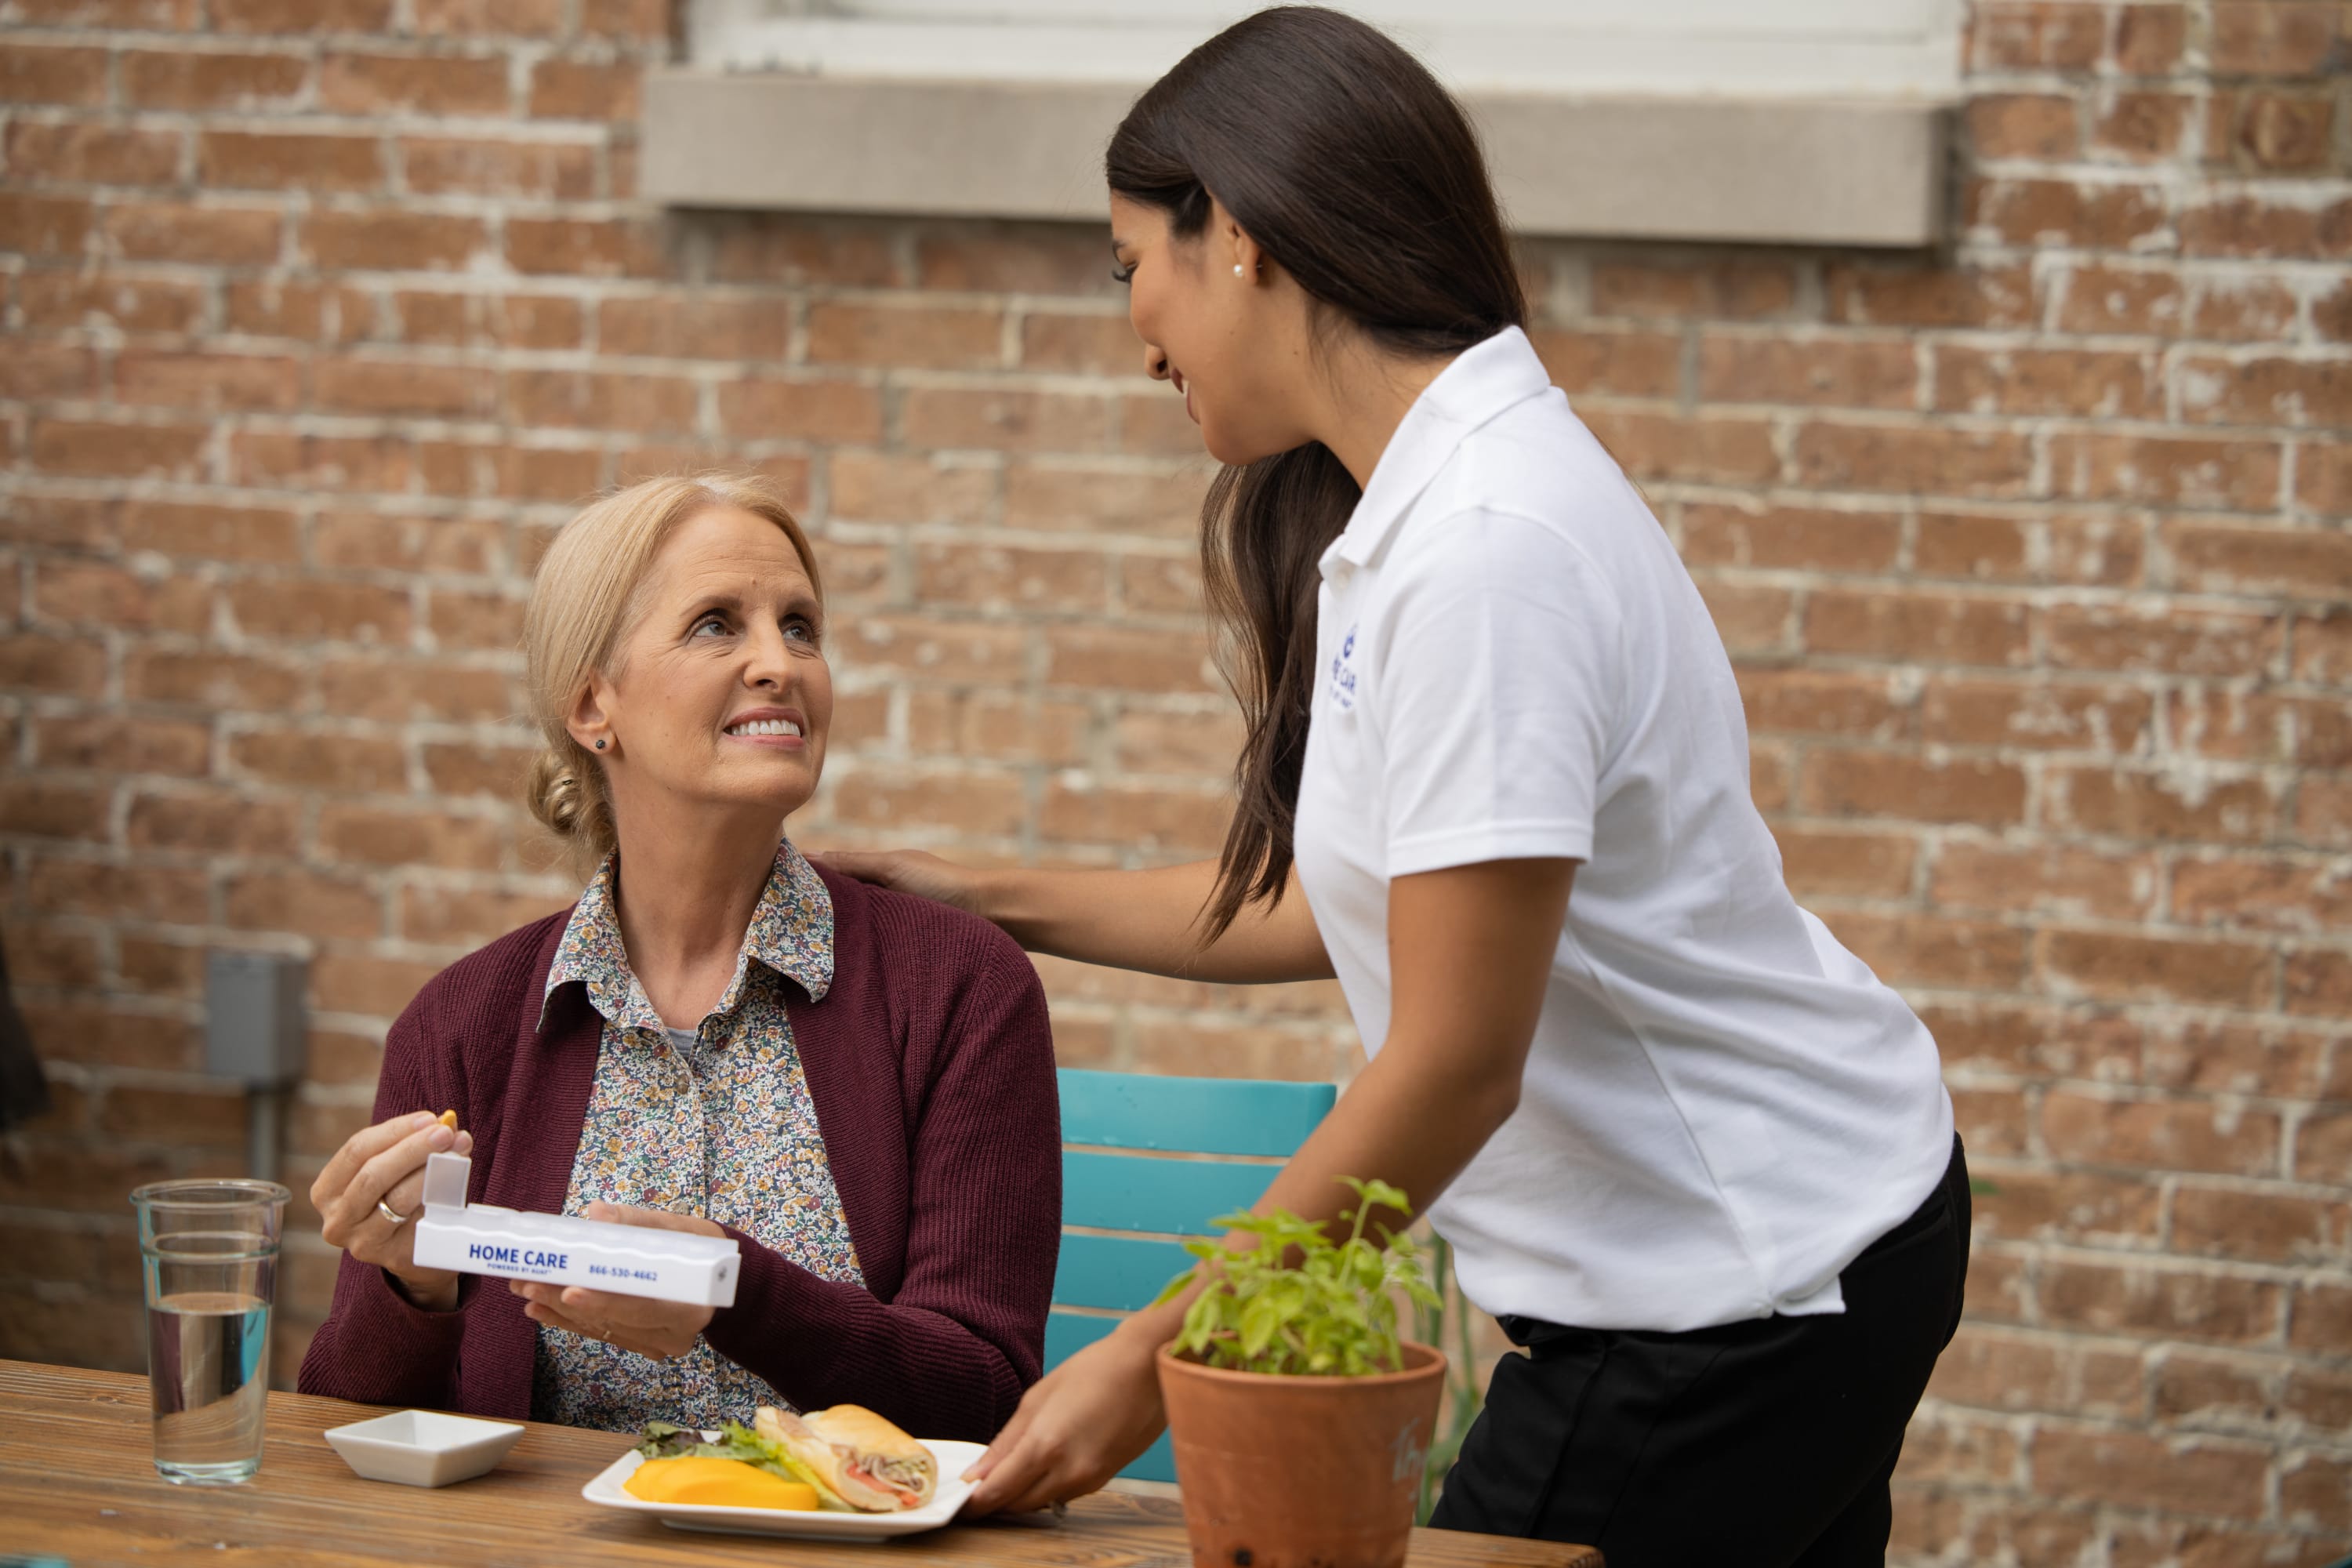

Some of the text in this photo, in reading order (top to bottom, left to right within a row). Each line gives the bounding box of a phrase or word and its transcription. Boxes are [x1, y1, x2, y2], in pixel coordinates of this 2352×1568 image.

[469, 1243, 568, 1269] HOME CARE
[488, 1262, 519, 1272] POWERED
[590, 1265, 658, 1281] 866-530-4662
